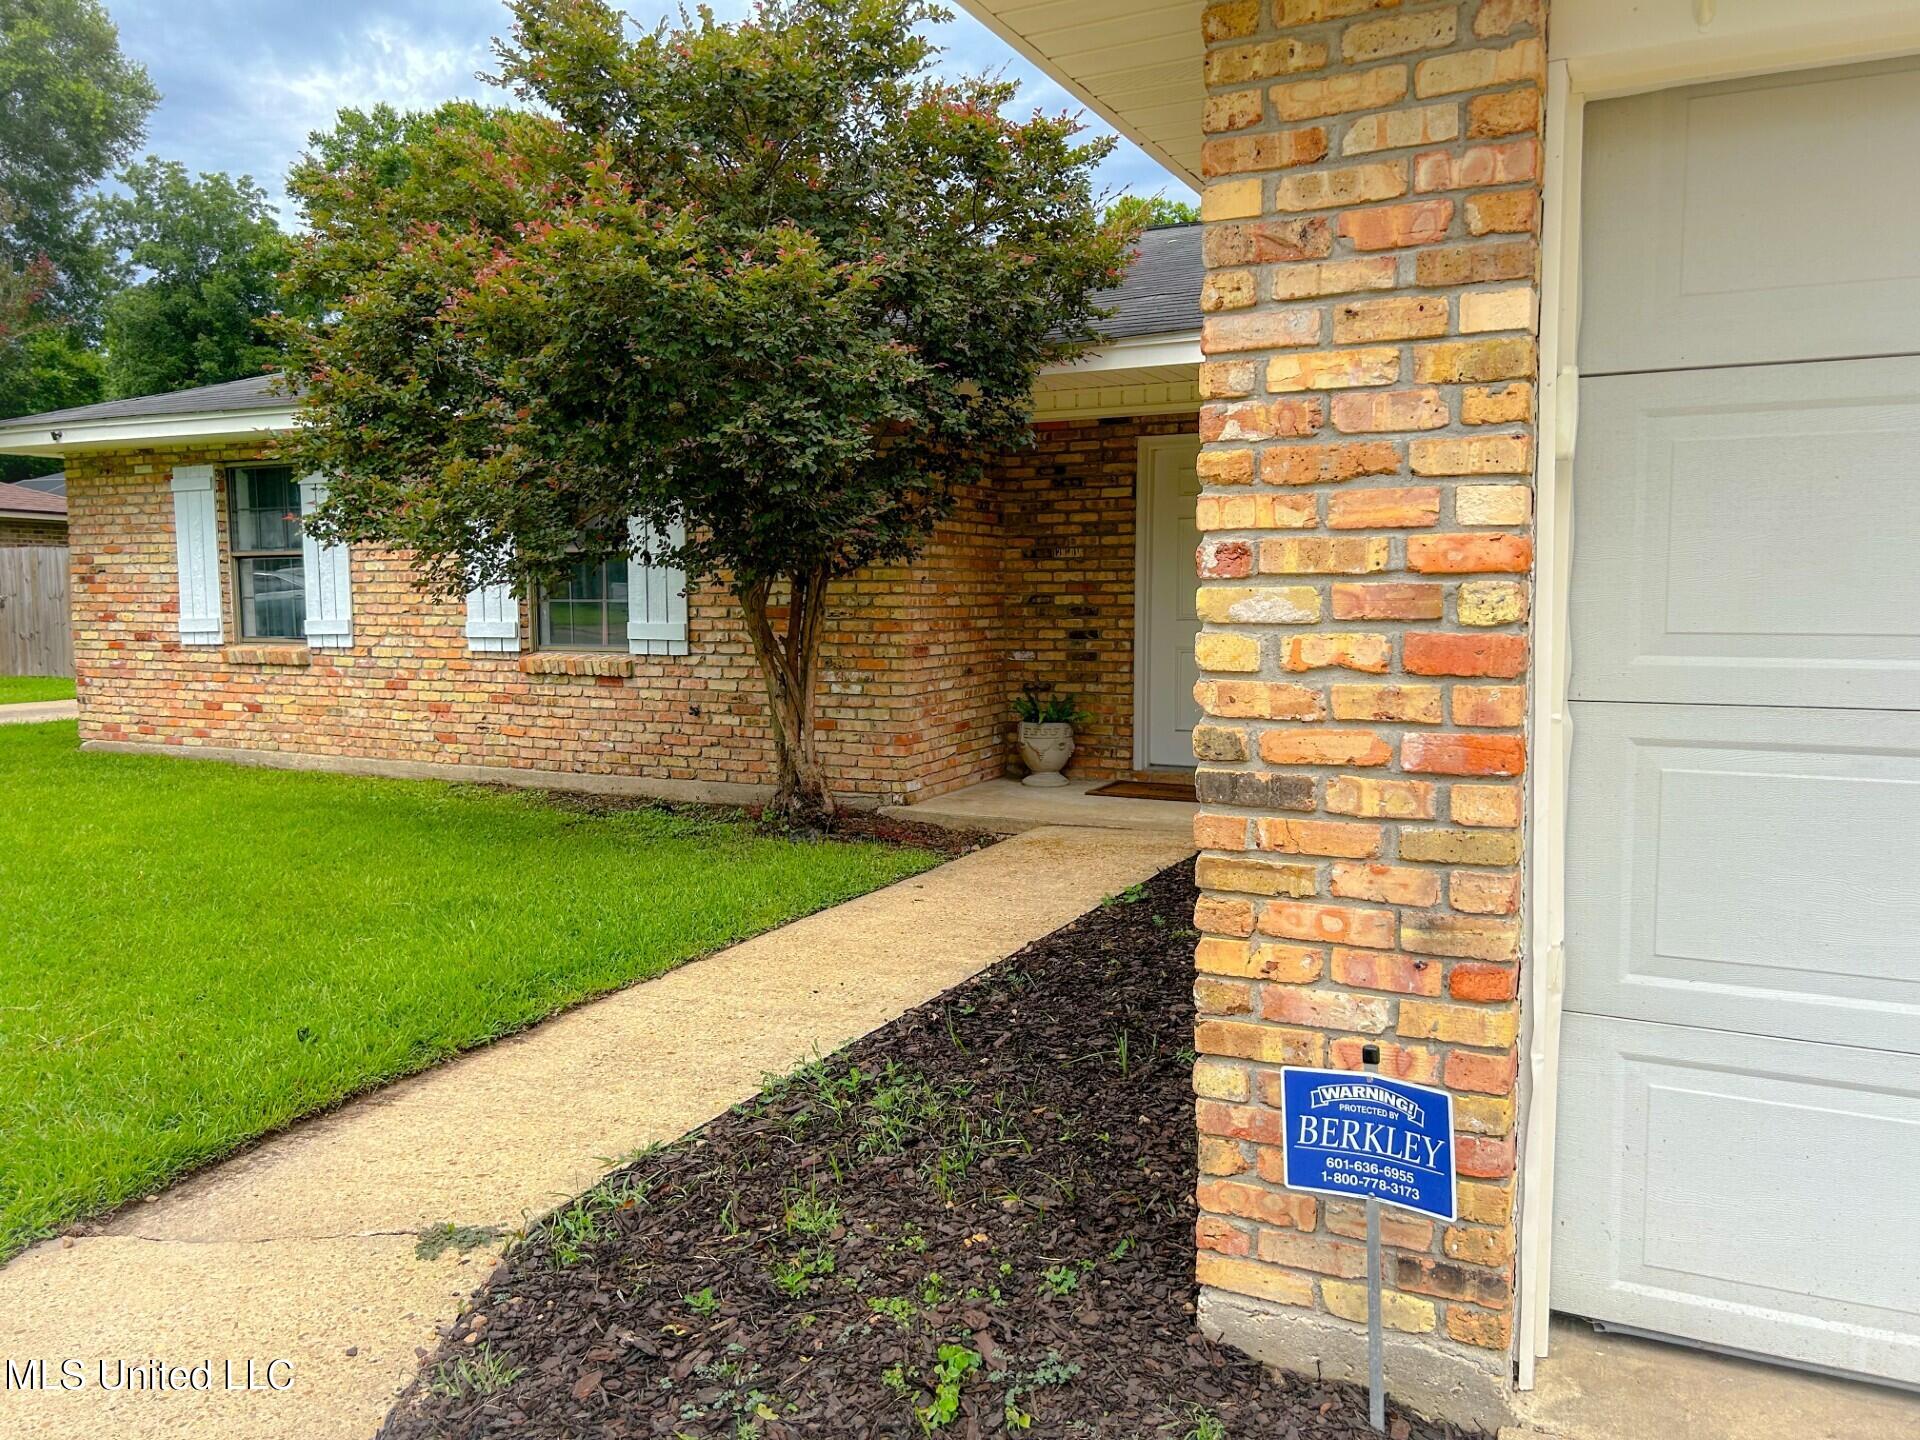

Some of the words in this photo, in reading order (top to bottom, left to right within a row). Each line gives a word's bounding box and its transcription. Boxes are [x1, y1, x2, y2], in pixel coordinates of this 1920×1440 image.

[1320, 1086, 1416, 1115] WARNING!
[1339, 1103, 1387, 1118] PROTECTED
[1389, 1111, 1400, 1121] BY
[1297, 1114, 1446, 1169] BERKLEY
[1326, 1157, 1415, 1184] 601-636-6955
[1321, 1171, 1421, 1200] 1-800-778-3173
